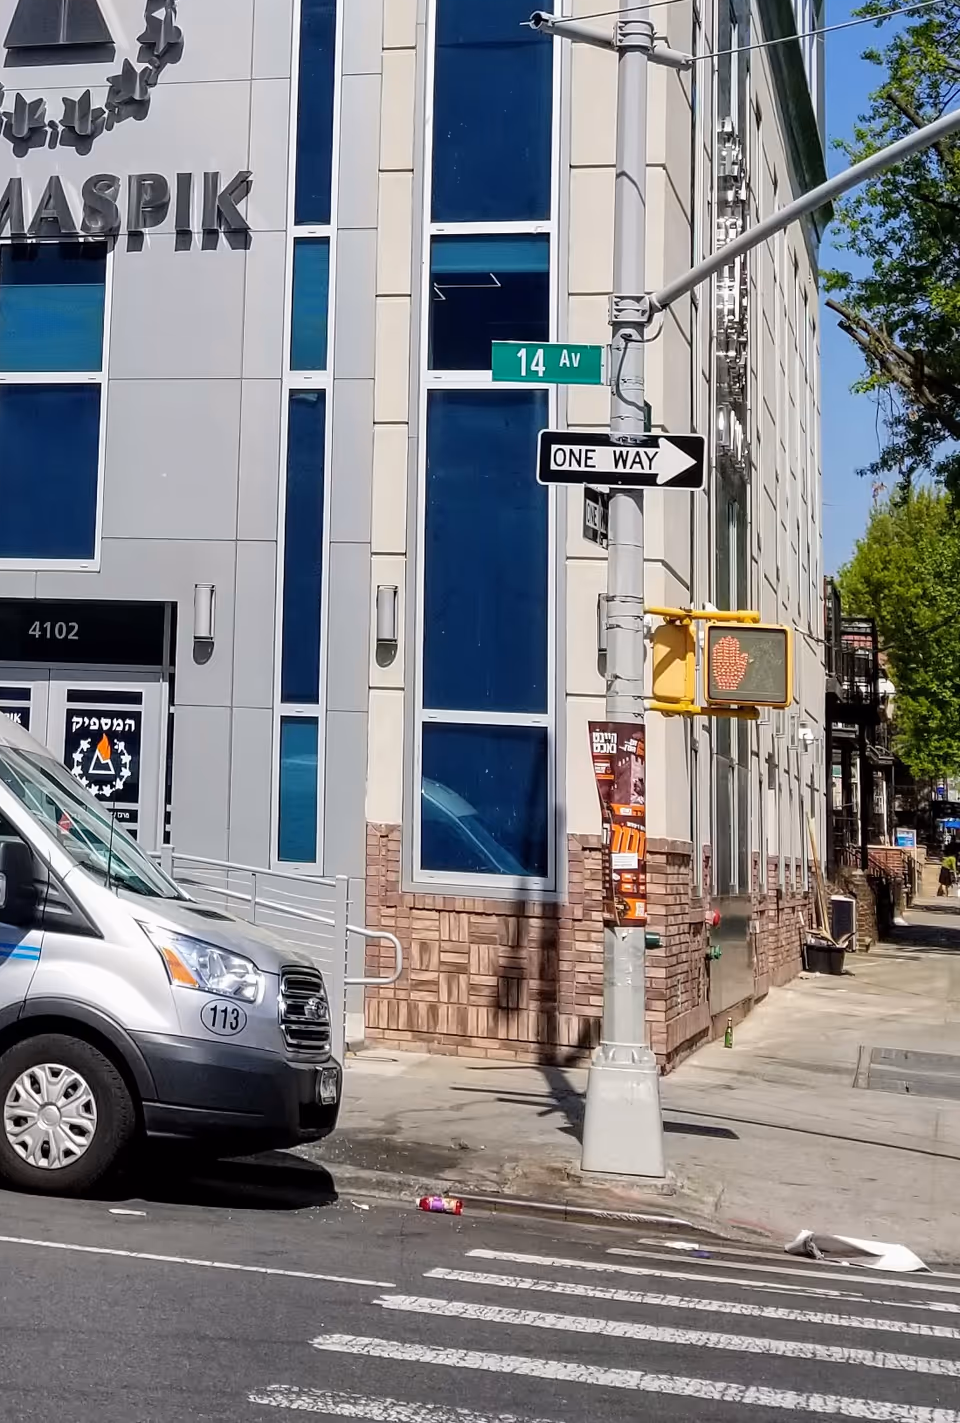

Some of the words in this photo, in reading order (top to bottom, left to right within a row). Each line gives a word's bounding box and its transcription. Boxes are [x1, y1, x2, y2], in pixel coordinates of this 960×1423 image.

[517, 347, 546, 377] 14
[553, 448, 596, 469] ONE
[612, 449, 659, 471] WAY
[28, 620, 79, 640] 4102
[71, 716, 135, 732] המספיק
[209, 1004, 240, 1031] 113
